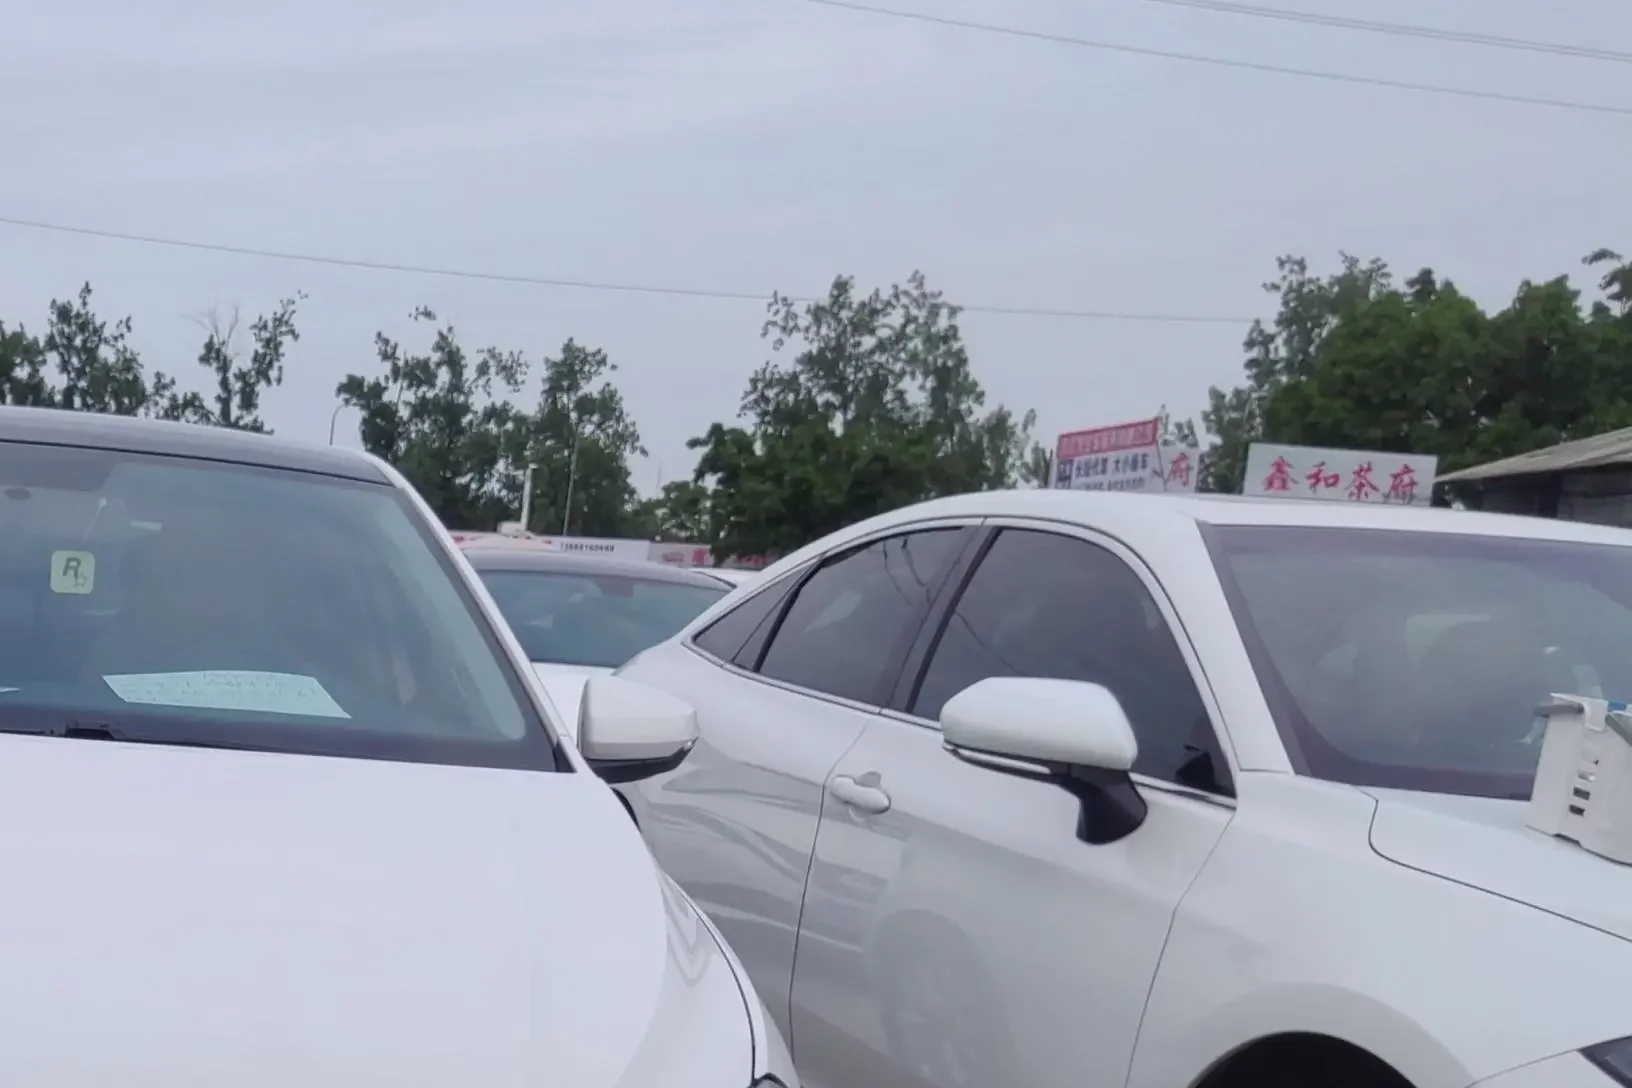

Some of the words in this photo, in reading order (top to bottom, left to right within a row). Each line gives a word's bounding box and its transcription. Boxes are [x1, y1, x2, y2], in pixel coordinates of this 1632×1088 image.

[1263, 455, 1419, 503] 鑫和茶府
[62, 557, 82, 578] R
